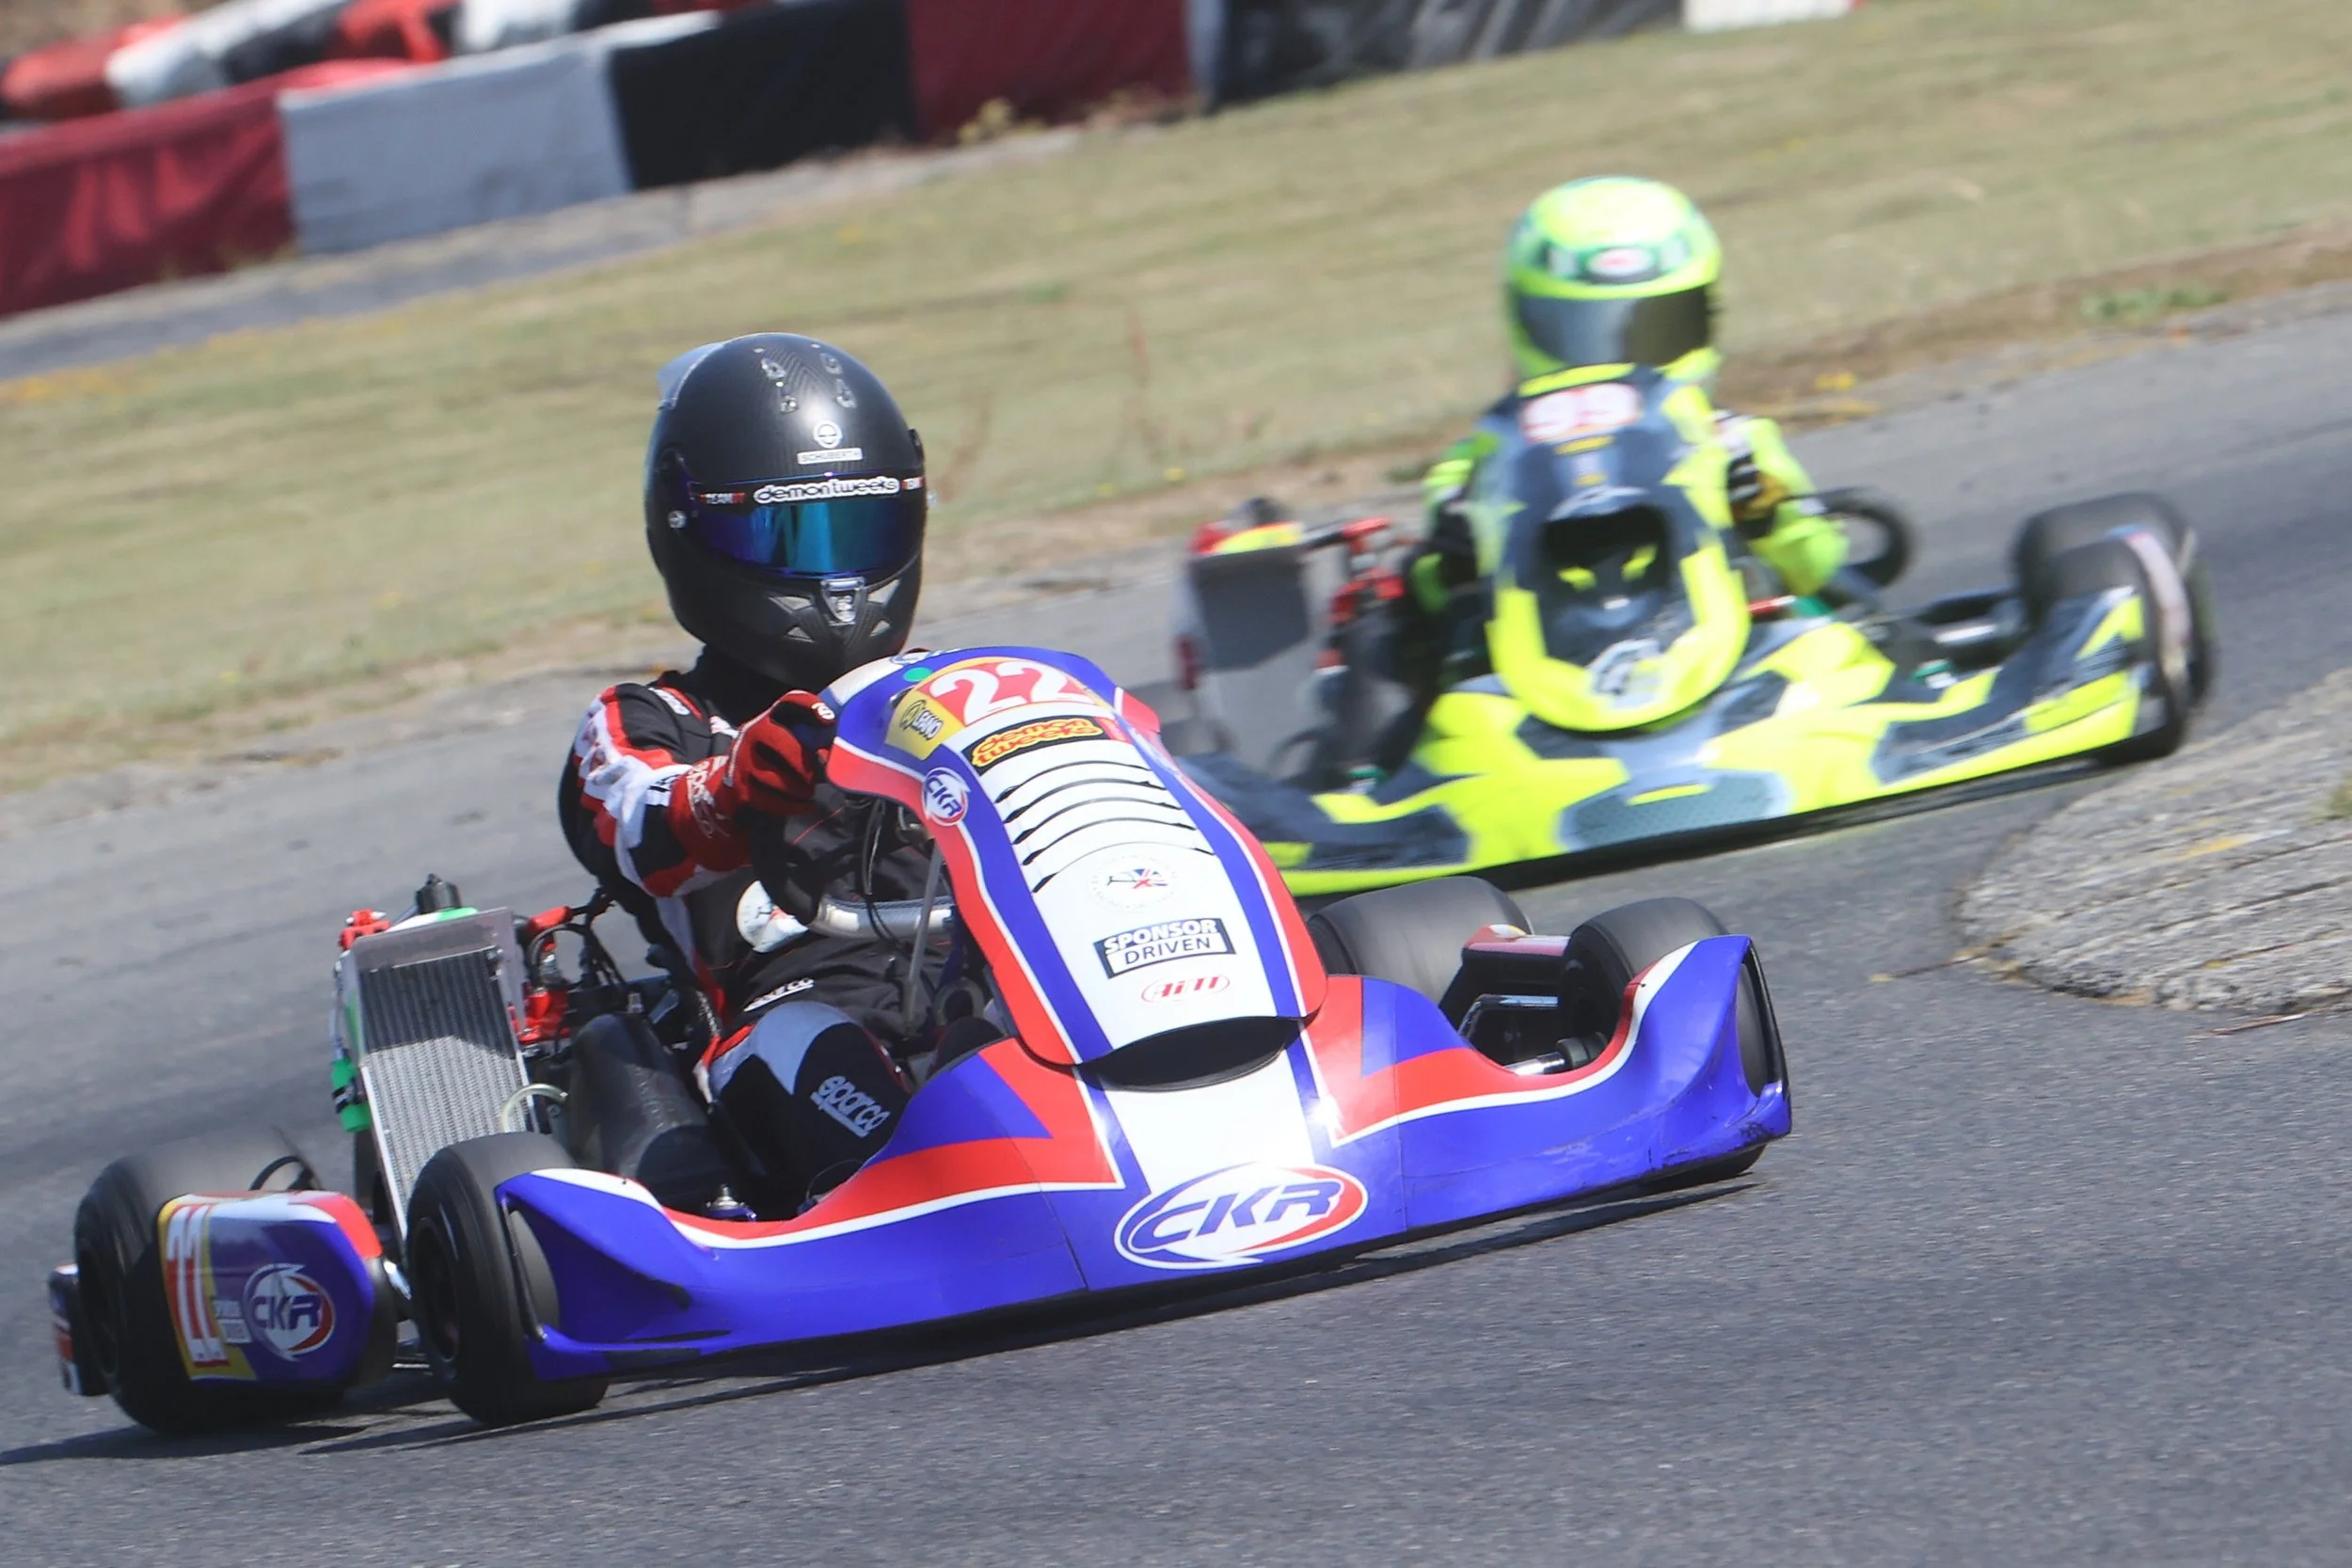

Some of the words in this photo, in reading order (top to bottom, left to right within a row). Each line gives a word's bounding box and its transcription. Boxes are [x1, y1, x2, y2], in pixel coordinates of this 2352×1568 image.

[930, 660, 1101, 727] 22
[926, 777, 962, 817] CKR
[1104, 919, 1219, 955] SPONSOR
[1124, 937, 1211, 965] DRIVEN
[1131, 1180, 1343, 1251] CKR
[250, 1294, 321, 1330] CKR
